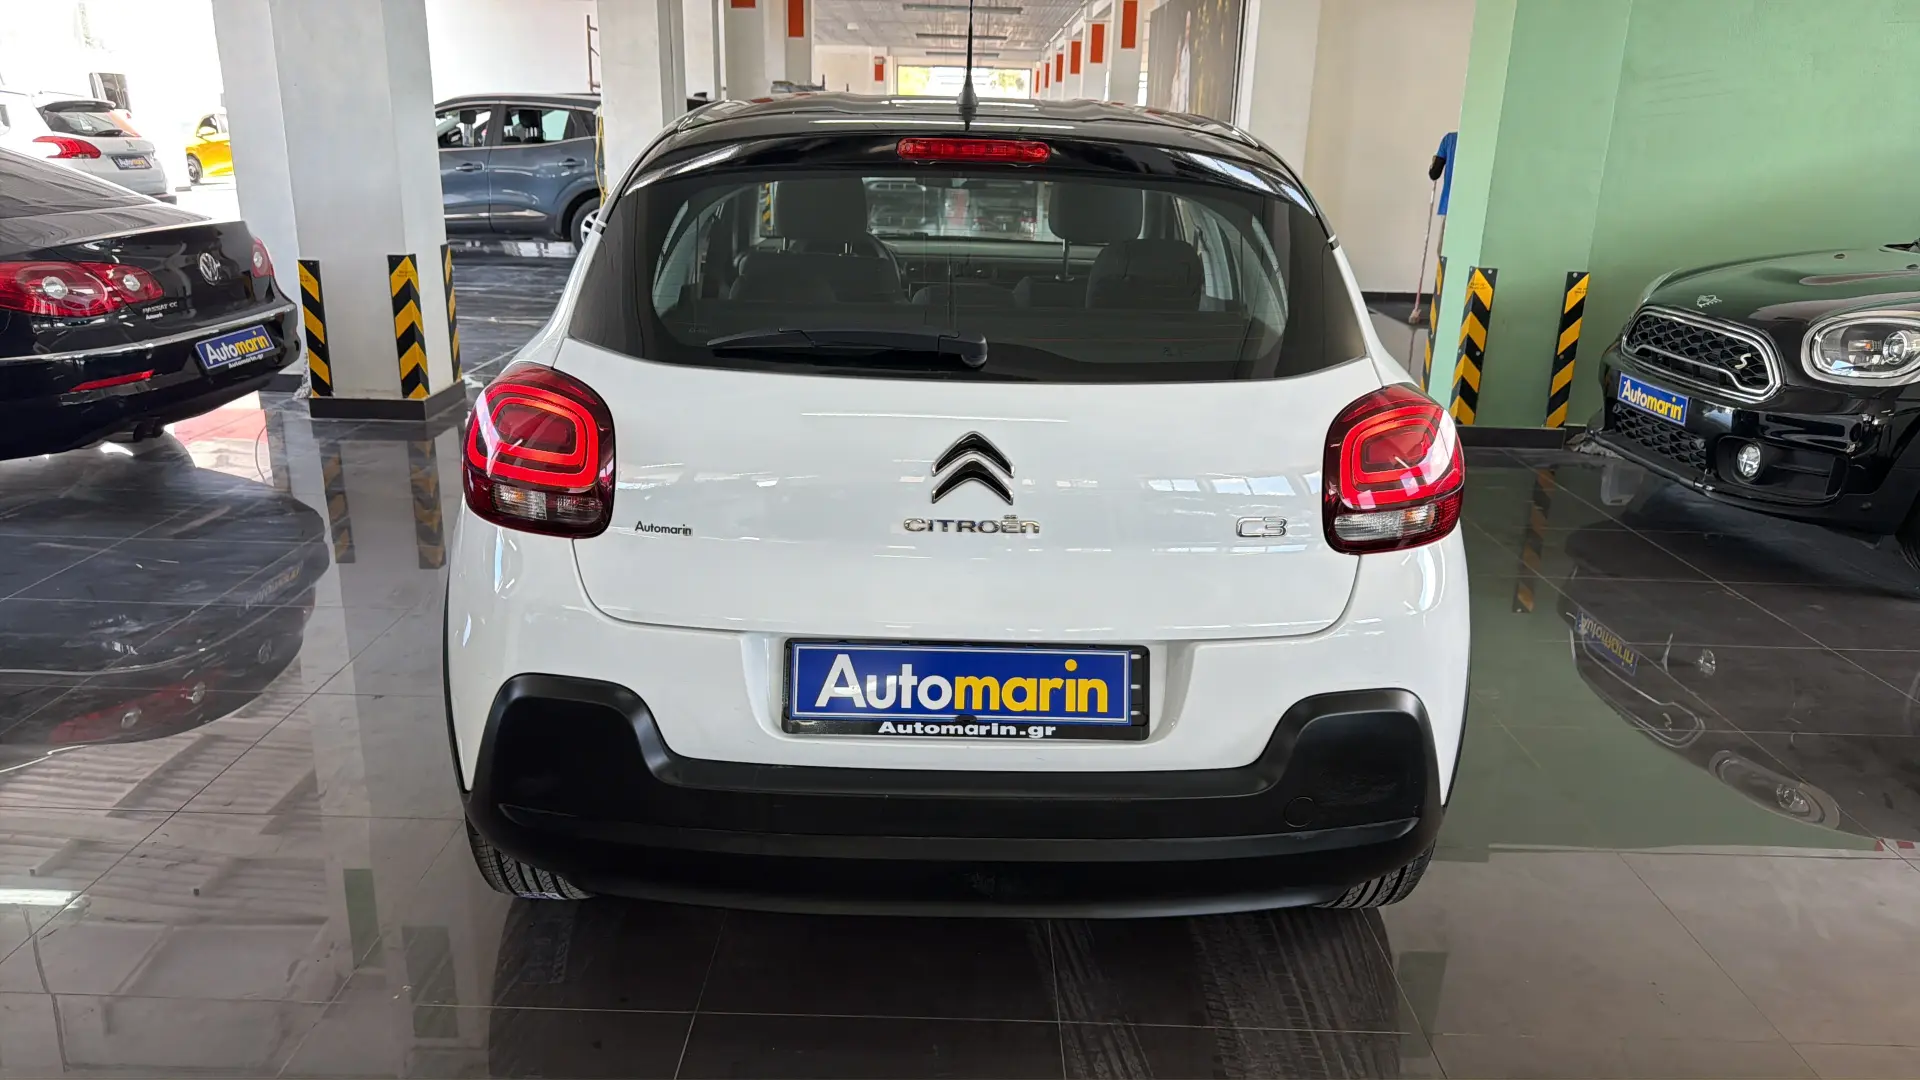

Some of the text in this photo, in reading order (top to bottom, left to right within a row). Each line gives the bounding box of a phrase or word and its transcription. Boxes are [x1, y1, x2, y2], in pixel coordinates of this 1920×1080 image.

[206, 331, 270, 365] Automarin
[1621, 379, 1683, 421] Automarin
[635, 520, 692, 536] Automarin
[1236, 516, 1287, 538] C3
[814, 653, 1108, 713] Automarin
[877, 720, 1057, 739] Automarin.gr
